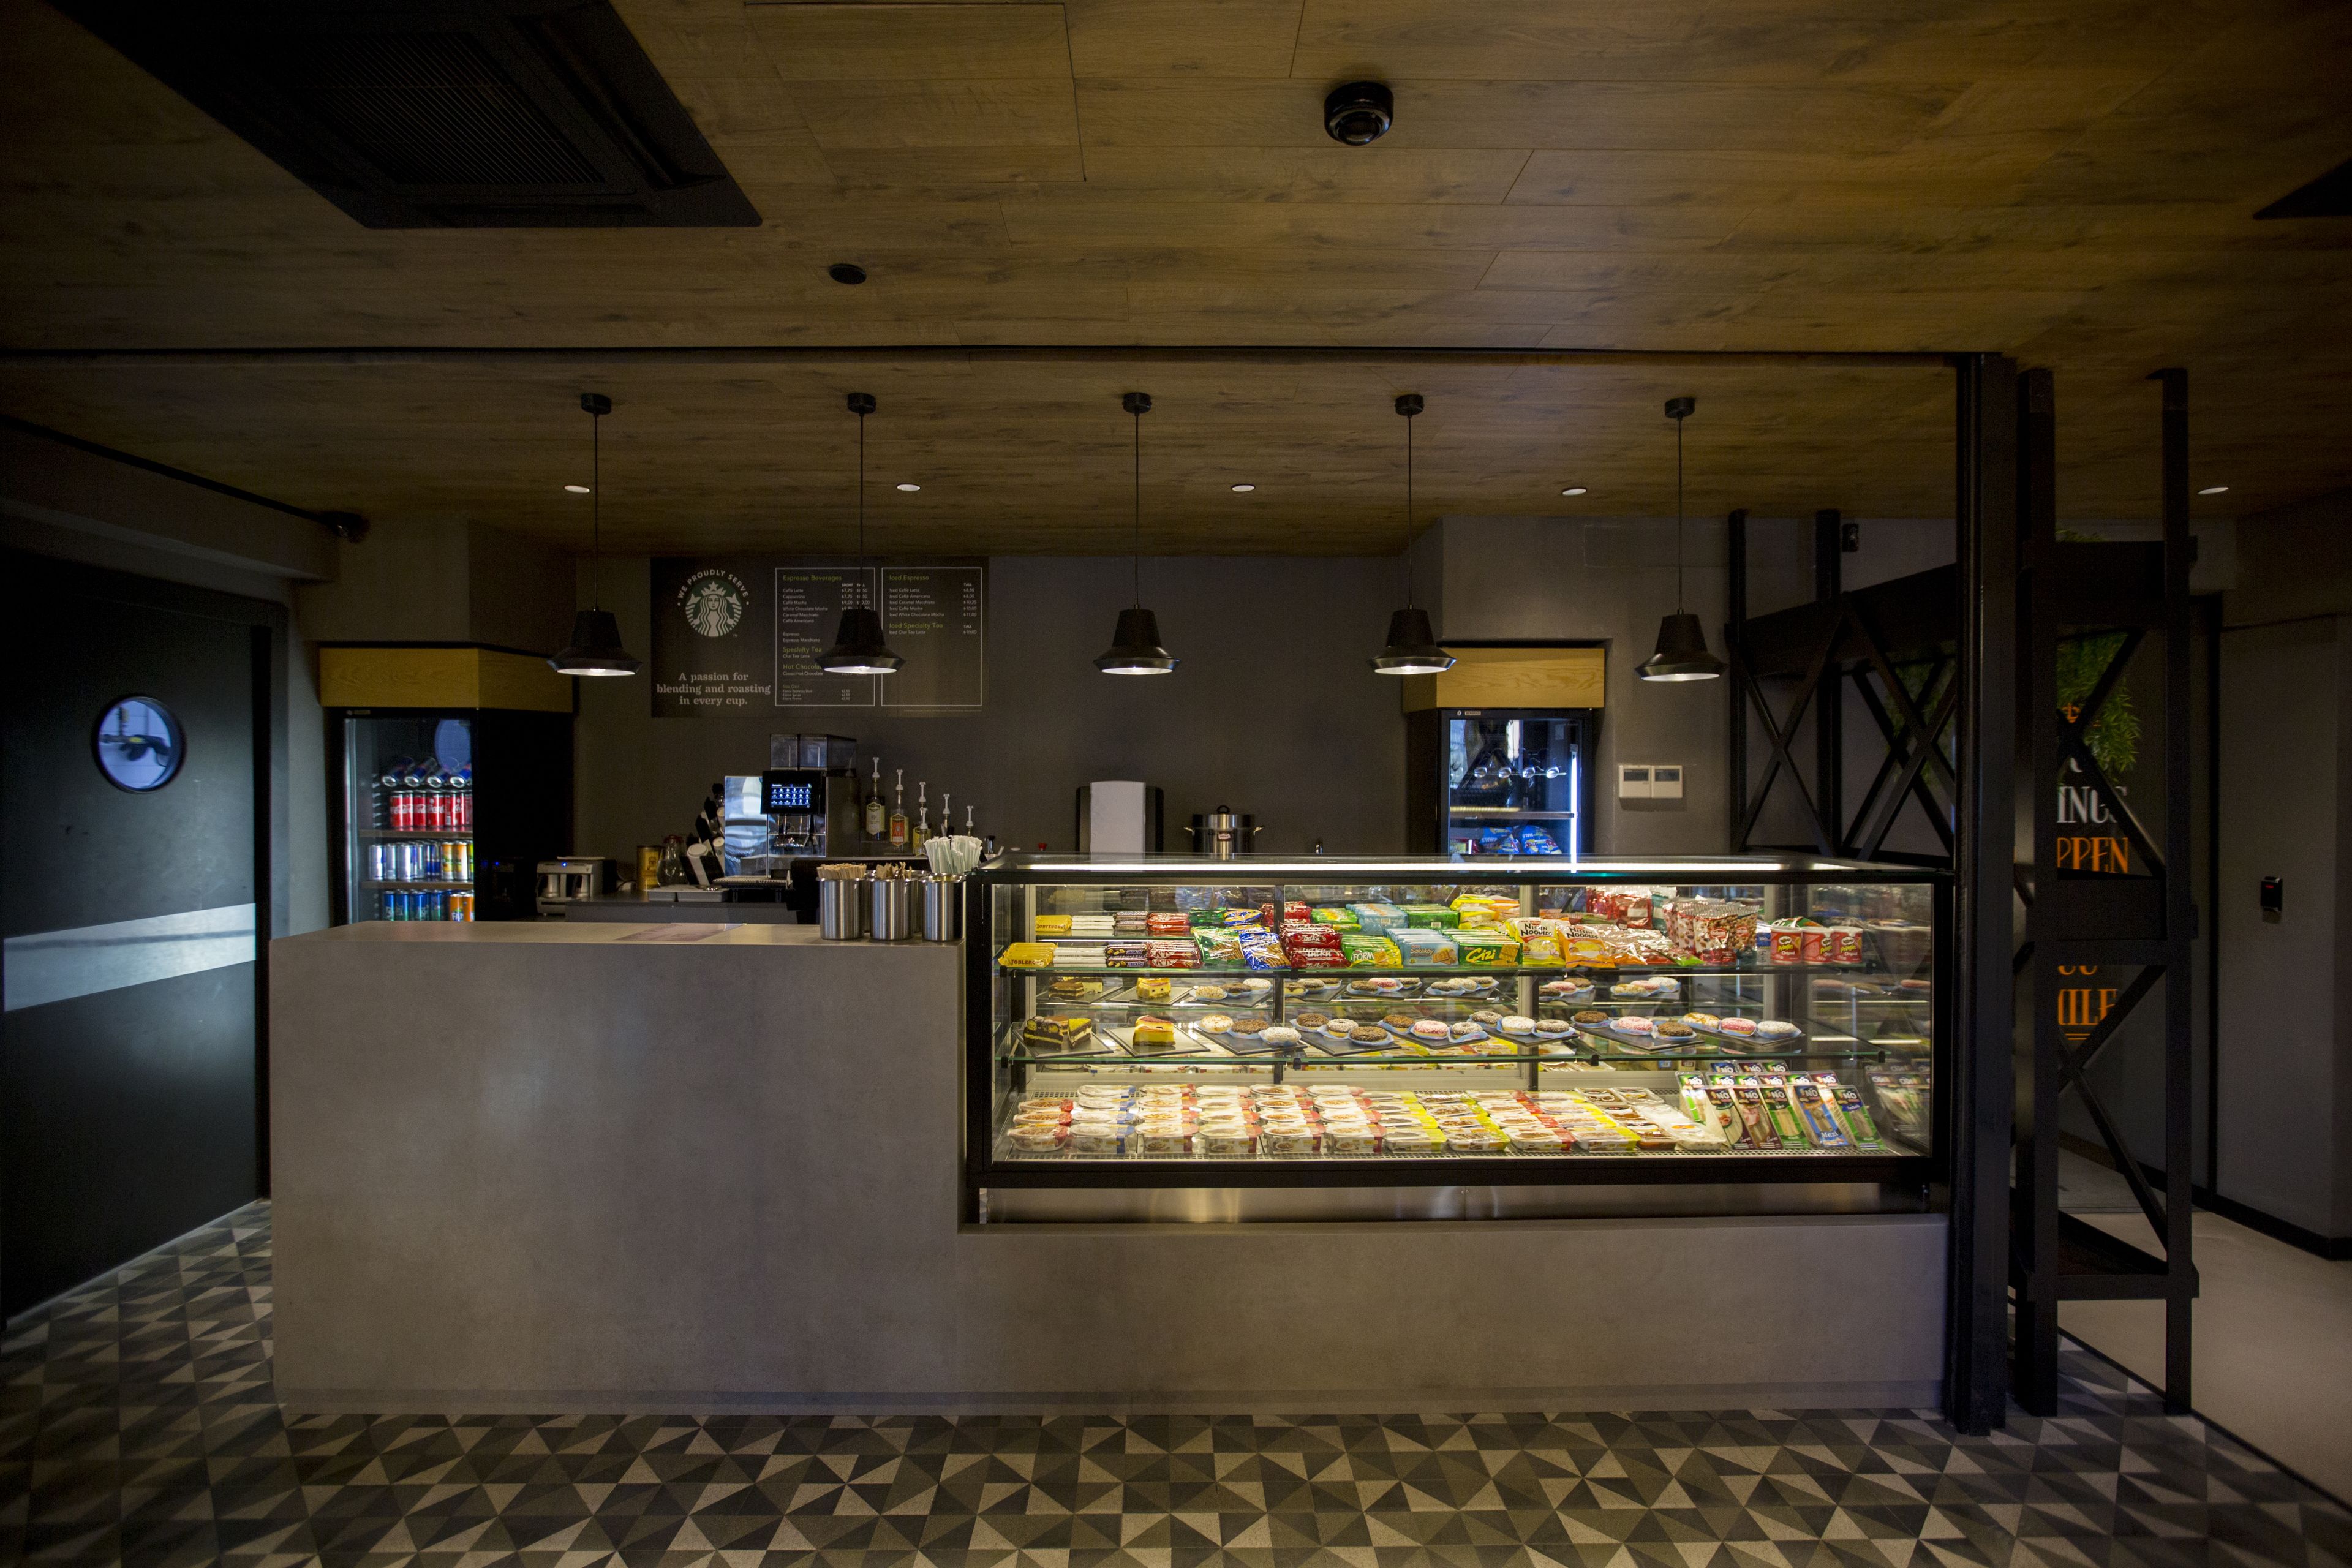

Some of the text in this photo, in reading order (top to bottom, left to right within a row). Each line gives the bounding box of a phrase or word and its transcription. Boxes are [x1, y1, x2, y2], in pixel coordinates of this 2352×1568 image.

[677, 569, 748, 599] WE PROUDLY SERVE
[678, 672, 748, 683] A passion for
[657, 684, 771, 695] blending and roasting
[679, 696, 748, 707] in every cup.
